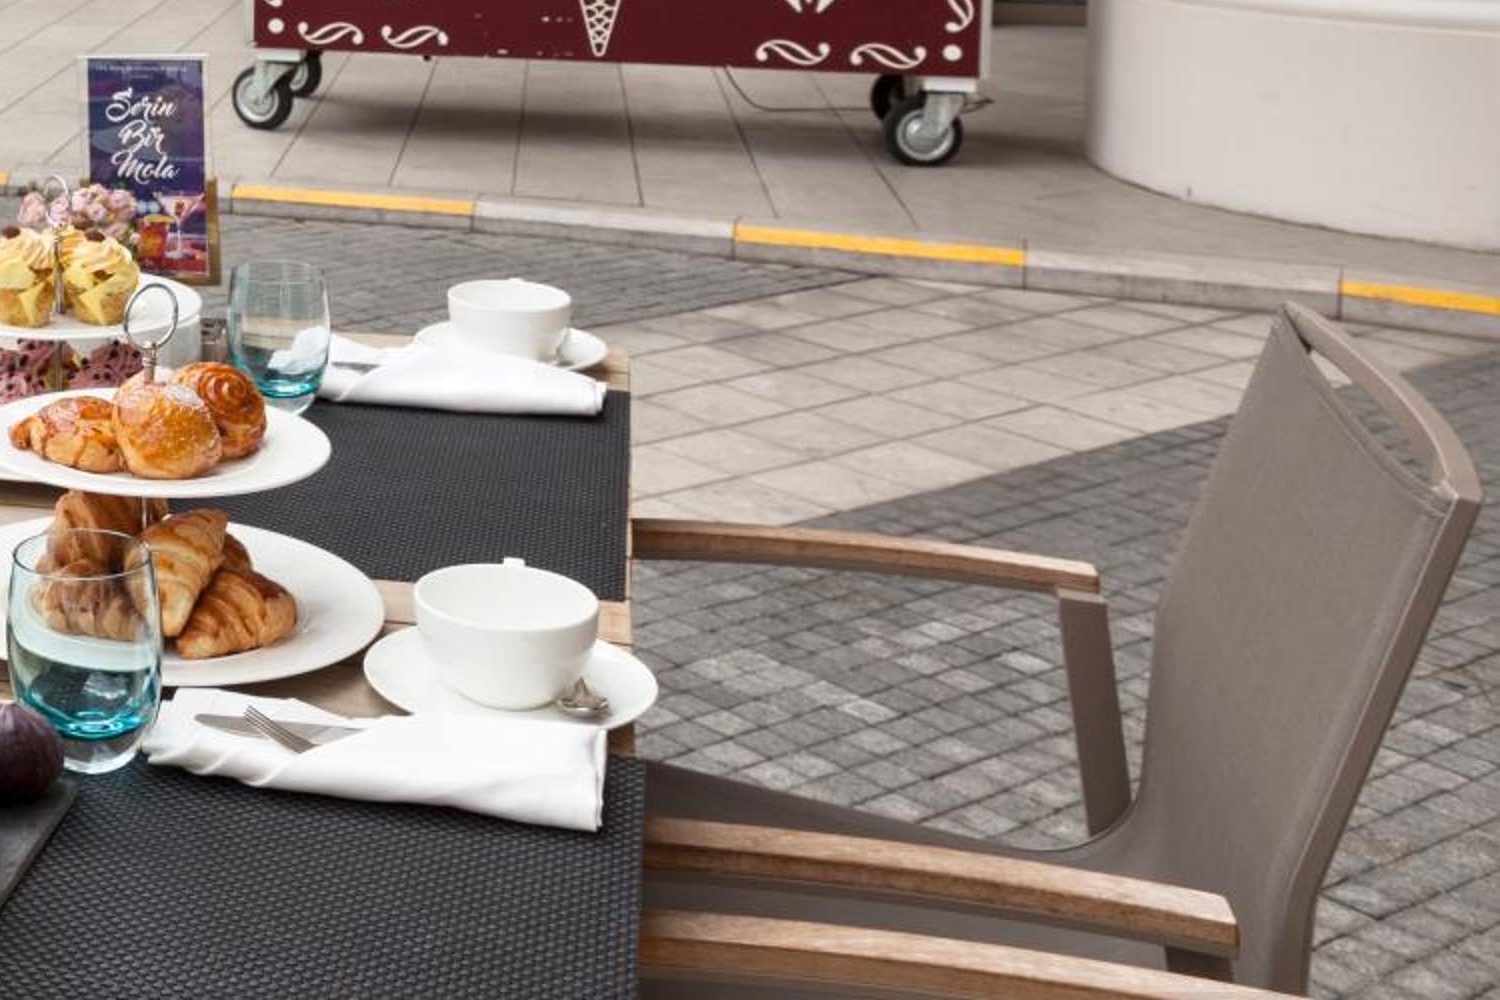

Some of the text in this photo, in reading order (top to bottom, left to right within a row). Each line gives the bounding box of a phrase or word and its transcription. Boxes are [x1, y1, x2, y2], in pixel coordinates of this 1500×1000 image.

[105, 87, 178, 122] Serin
[118, 119, 165, 154] Bir
[111, 150, 181, 185] Mola
